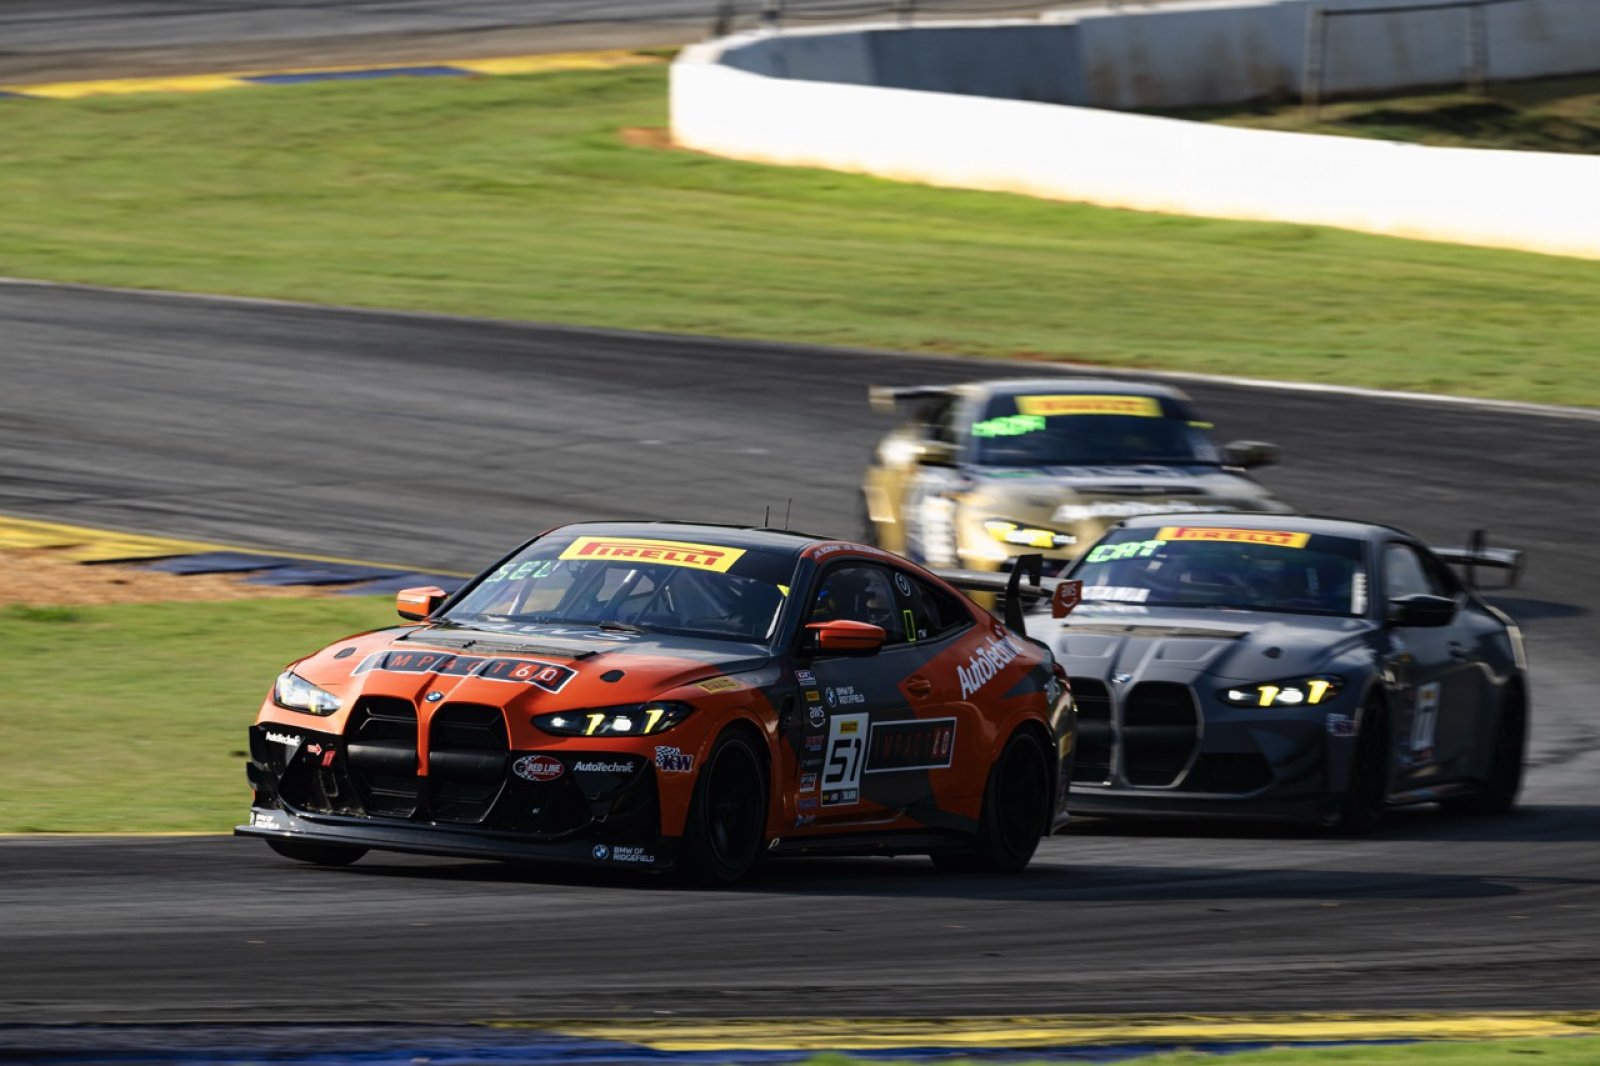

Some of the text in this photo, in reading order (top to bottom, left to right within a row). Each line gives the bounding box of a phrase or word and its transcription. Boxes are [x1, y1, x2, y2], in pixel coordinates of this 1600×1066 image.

[1175, 527, 1294, 545] PIRELLI
[577, 541, 726, 566] PIRELLI
[1085, 540, 1167, 563] CAT
[528, 763, 561, 773] RED LINE
[574, 760, 635, 773] AutoTechnic
[825, 738, 862, 783] 51
[613, 853, 655, 863] RIDGEFIELD
[614, 846, 645, 855] BMW OF
